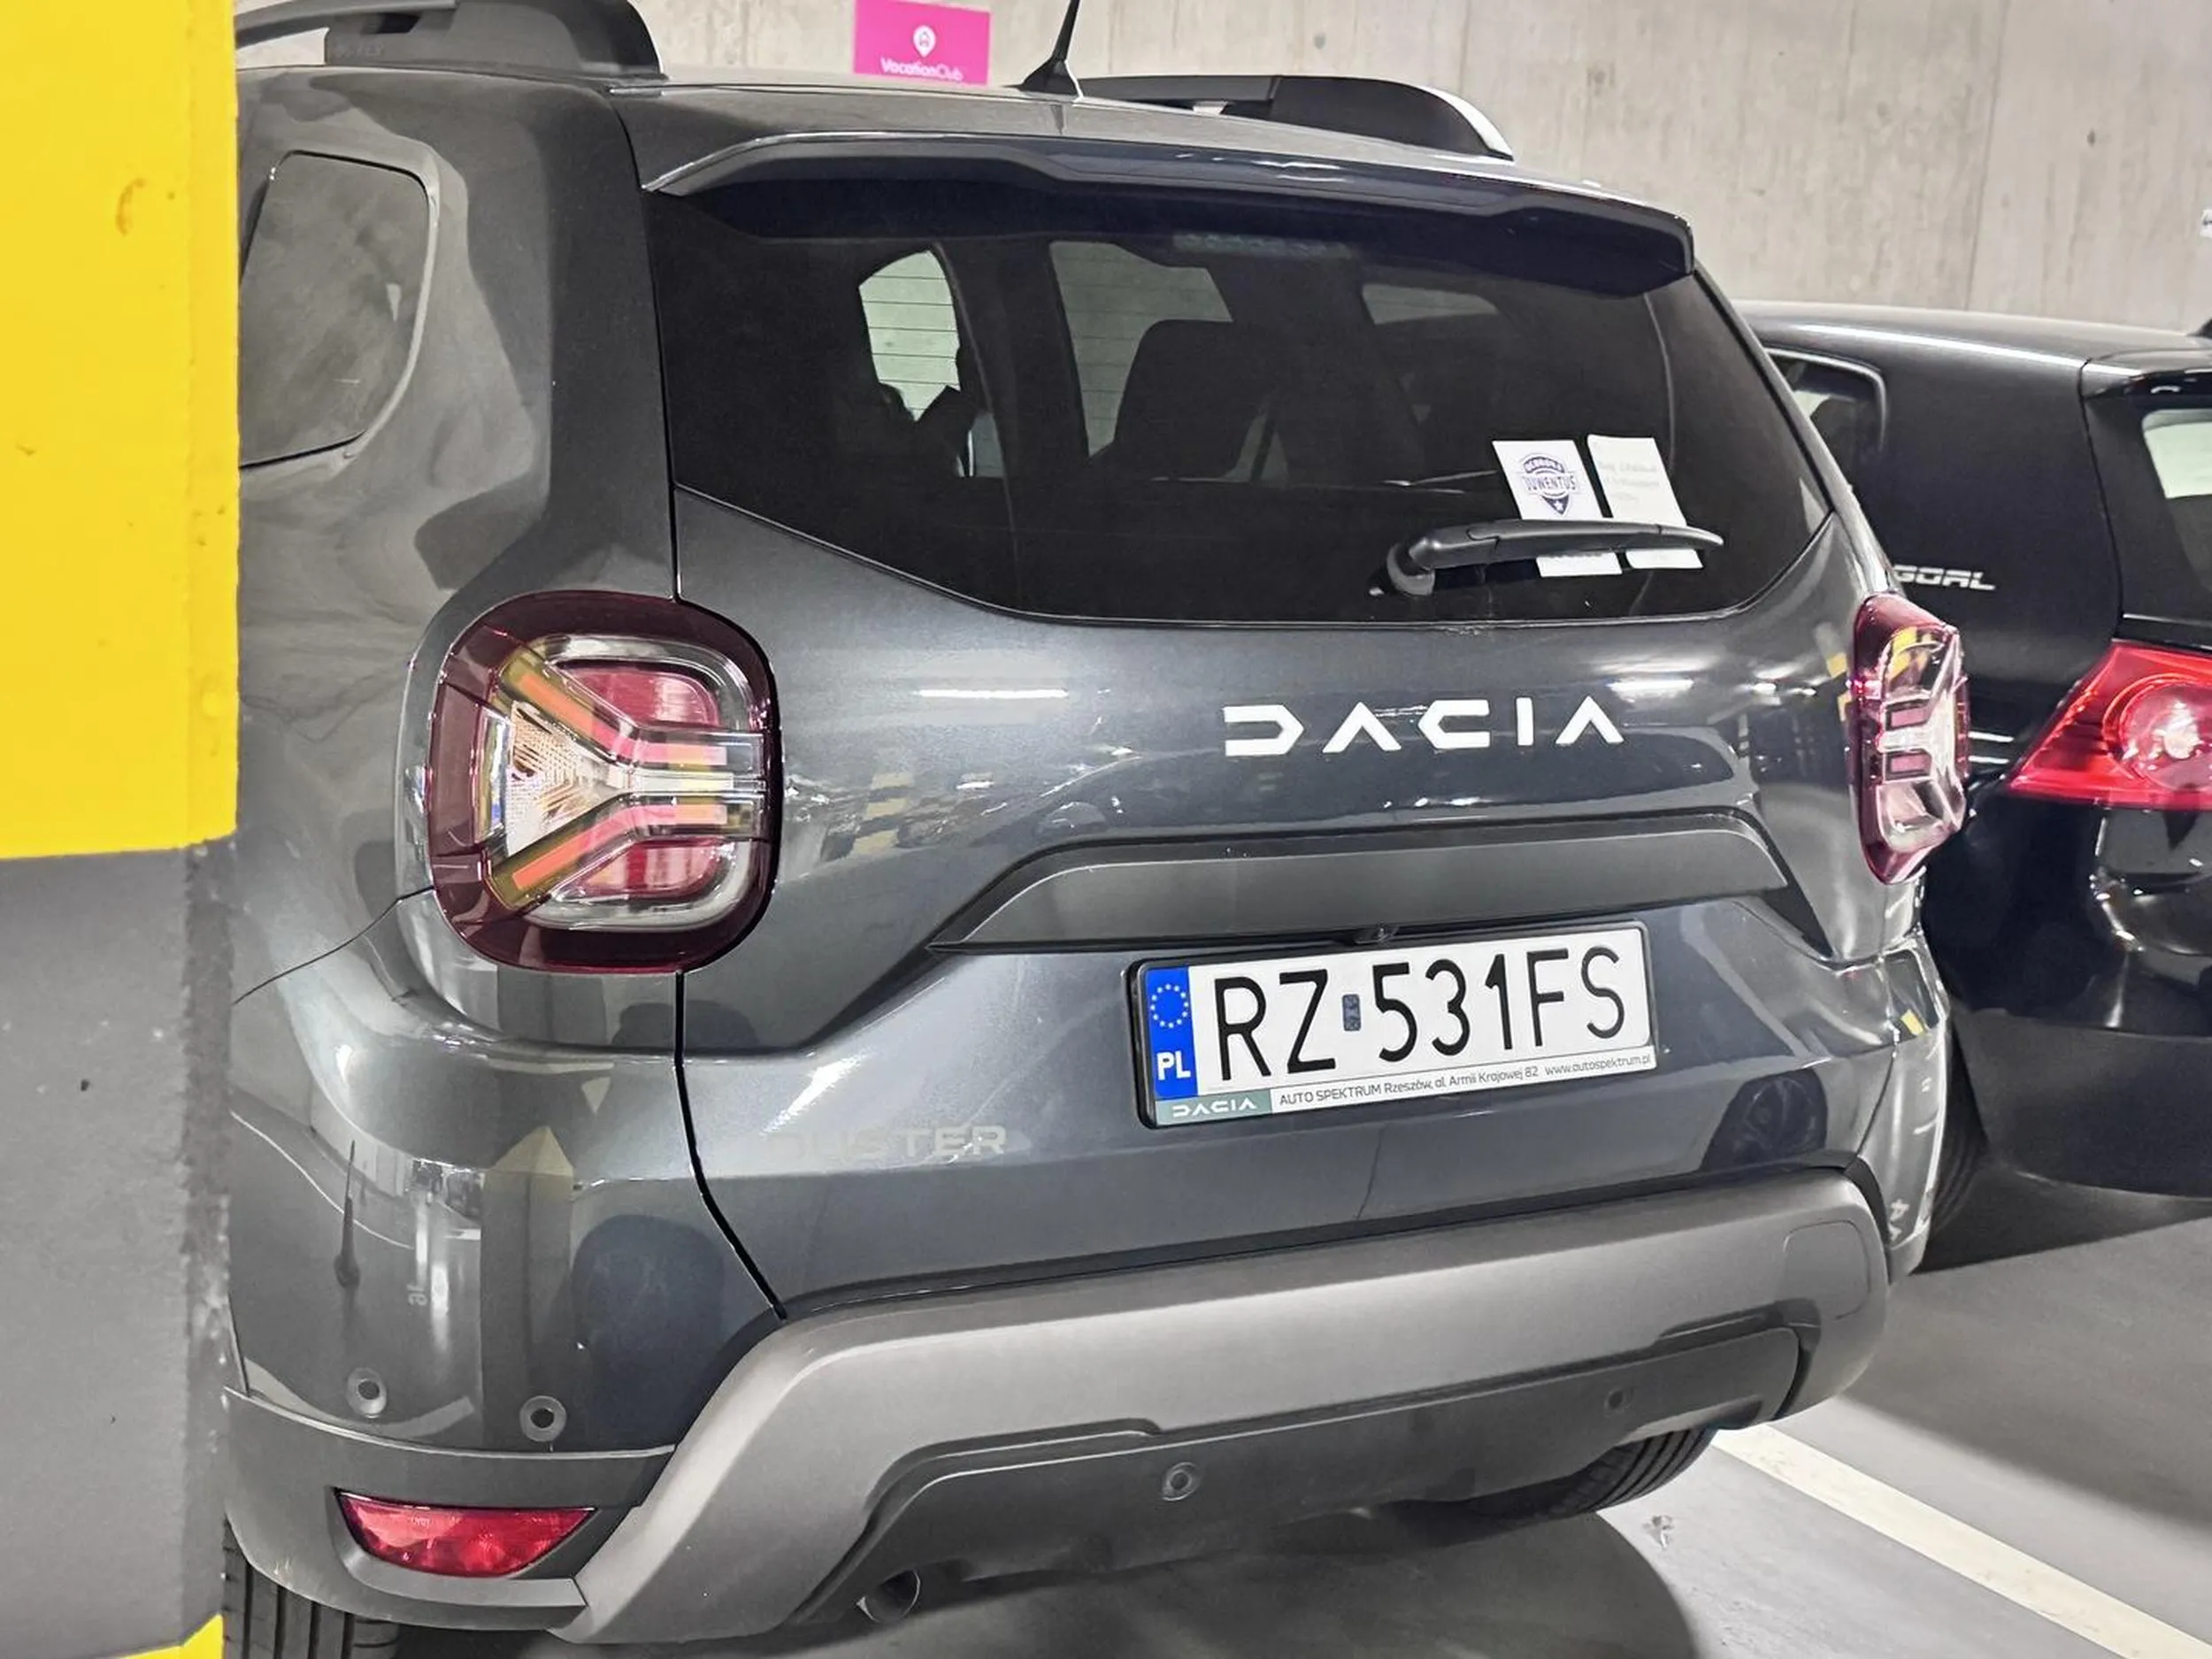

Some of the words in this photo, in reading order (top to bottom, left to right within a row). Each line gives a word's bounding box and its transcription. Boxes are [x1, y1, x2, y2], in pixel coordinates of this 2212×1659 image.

[1893, 564, 1996, 590] GOAL
[1223, 695, 1624, 757] DACIA
[1214, 969, 1336, 1080] RZ
[1372, 946, 1626, 1063] 531FS
[1157, 1051, 1191, 1080] PL
[1279, 1091, 1314, 1106] AUTO
[1316, 1083, 1382, 1102] SPEKTRUM
[1449, 1072, 1478, 1087] Armii
[1479, 1068, 1524, 1086] Krajowej
[1525, 1066, 1539, 1078] 82
[1544, 1053, 1652, 1076] www.autospektrum.pl
[1171, 1096, 1257, 1118] DACIA
